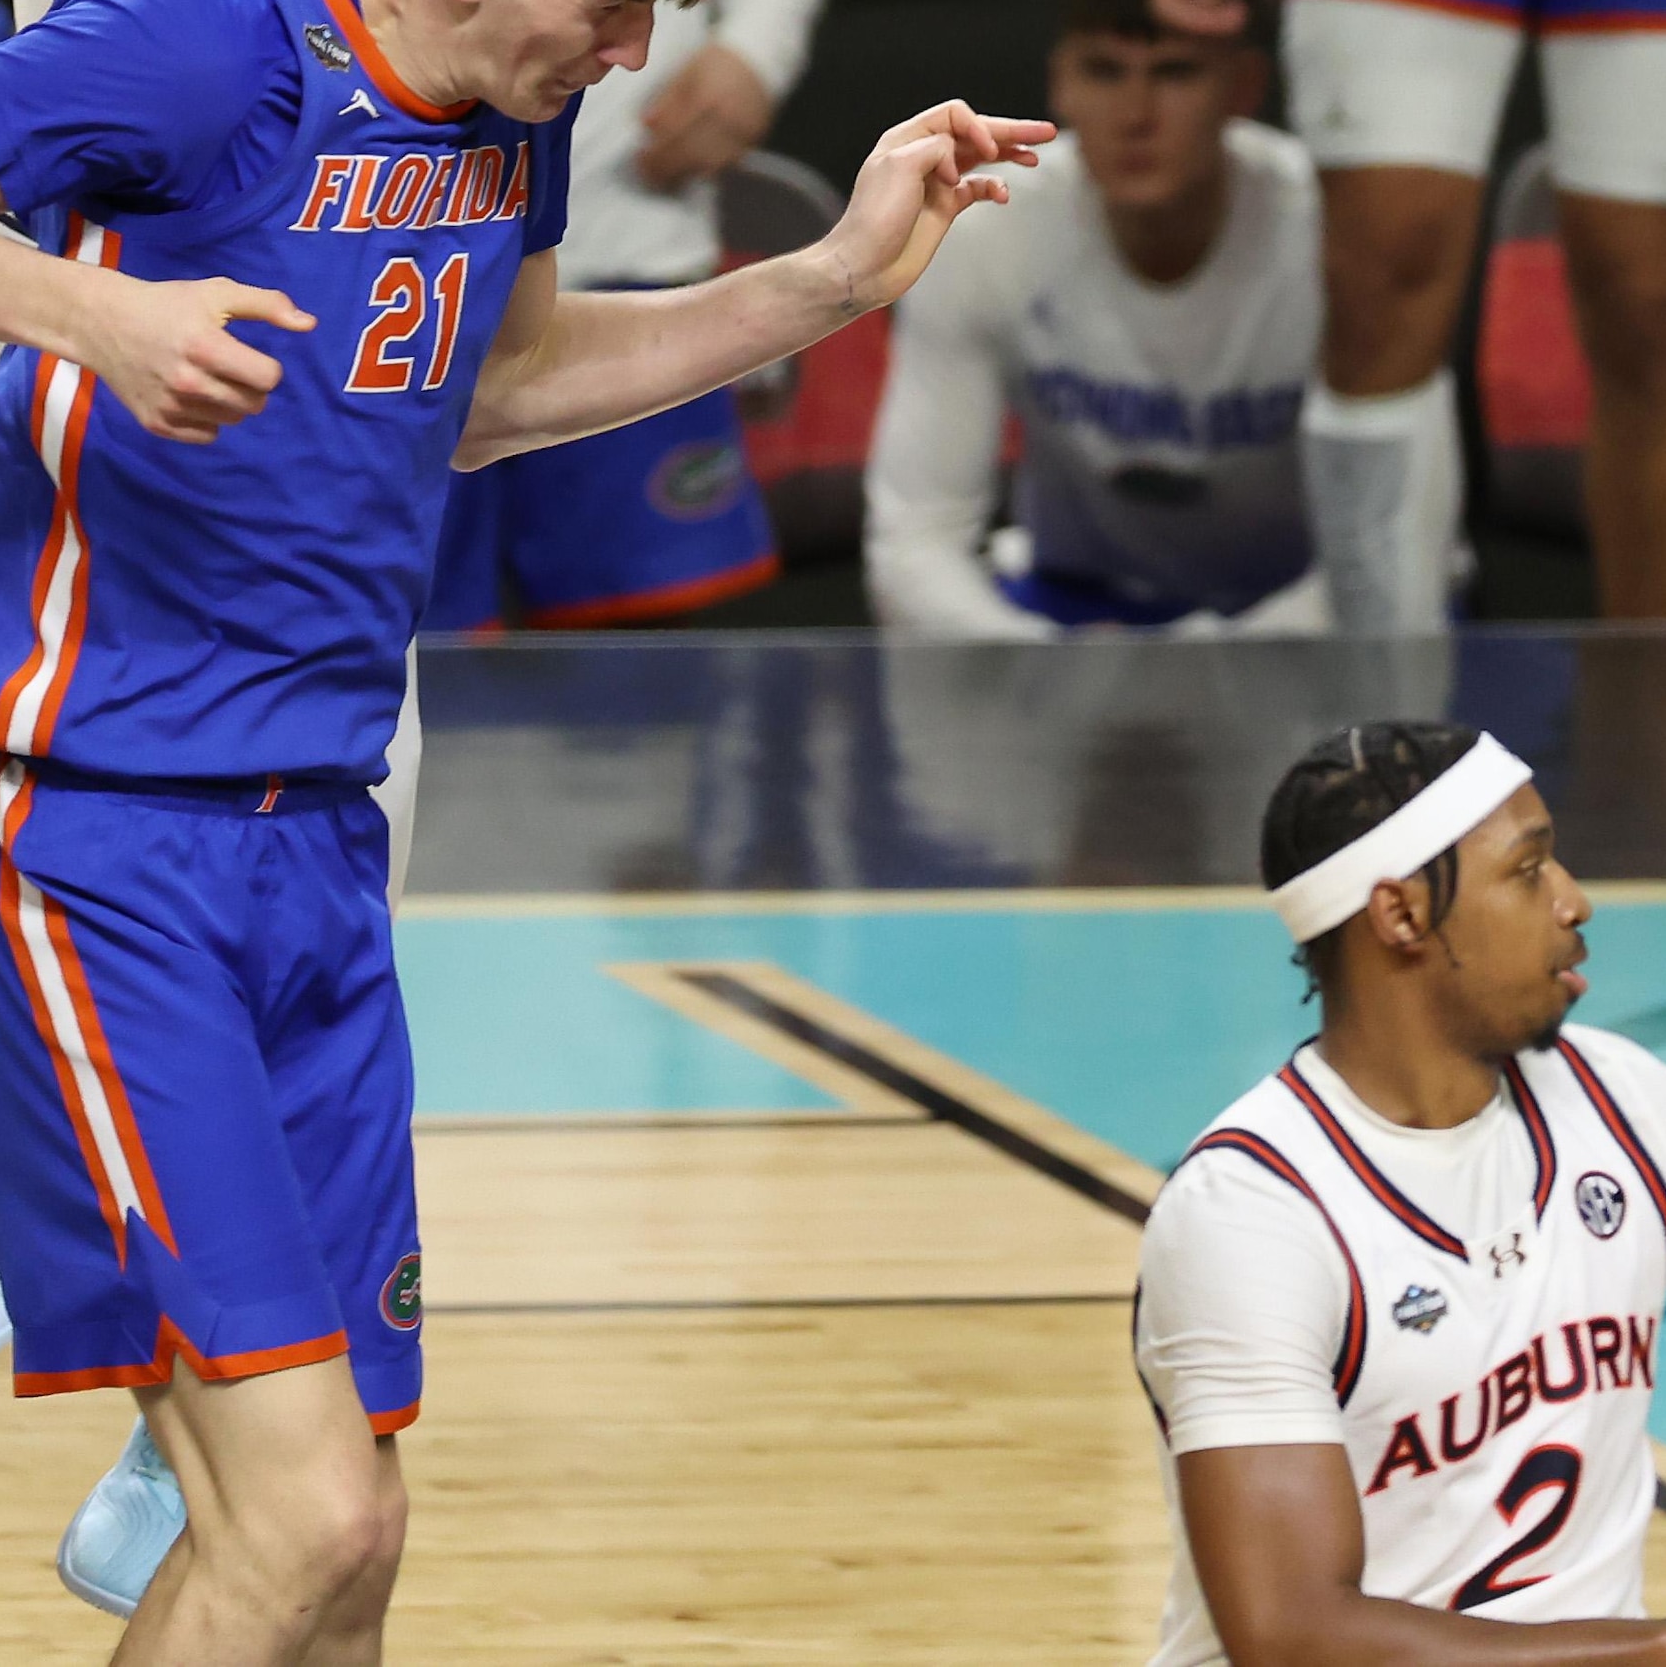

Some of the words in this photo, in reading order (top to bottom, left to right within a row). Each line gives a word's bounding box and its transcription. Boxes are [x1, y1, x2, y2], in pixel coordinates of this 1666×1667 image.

[343, 252, 470, 394] 21
[1364, 1314, 1659, 1497] AUBURN
[1449, 1443, 1583, 1612] 2
